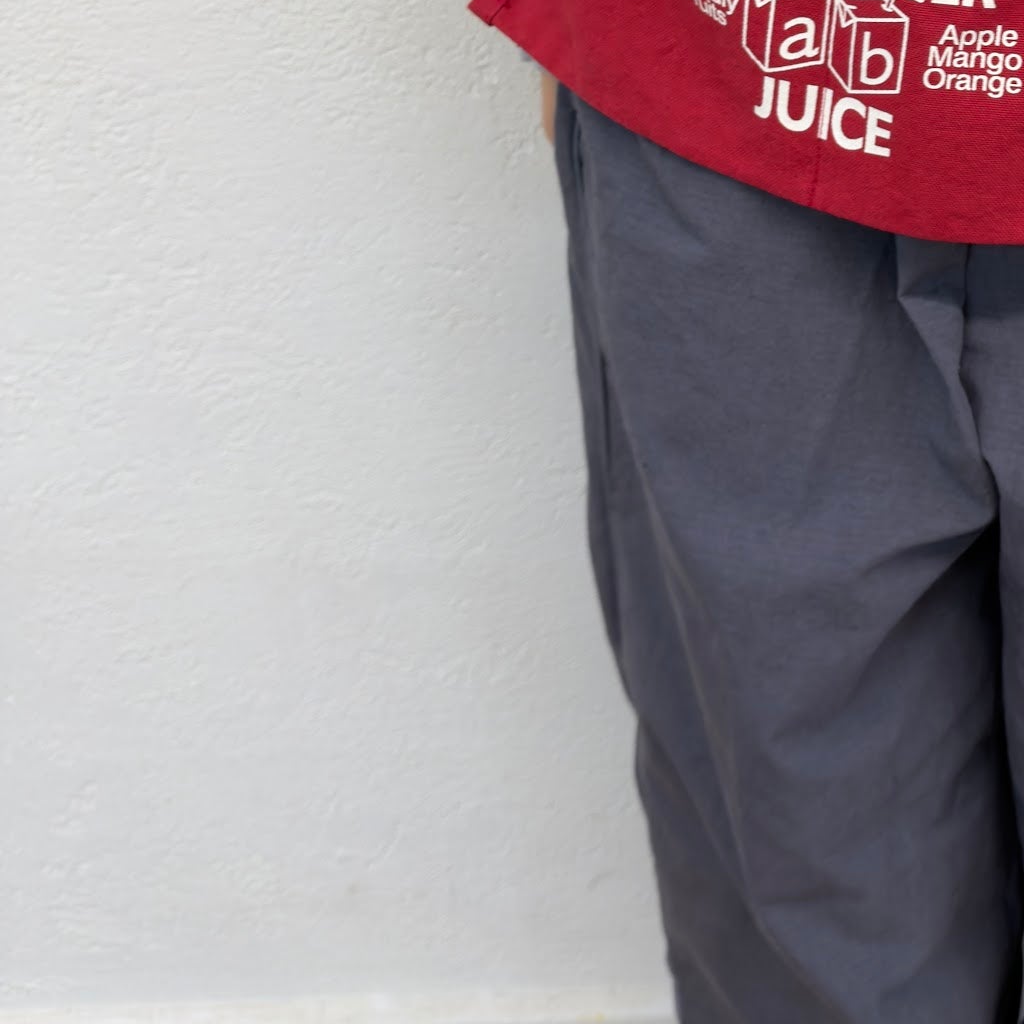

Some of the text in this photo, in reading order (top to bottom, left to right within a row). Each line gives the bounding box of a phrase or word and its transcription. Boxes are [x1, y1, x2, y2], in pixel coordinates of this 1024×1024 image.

[778, 16, 821, 61] a
[938, 24, 1019, 54] Apple
[860, 31, 894, 85] b
[927, 46, 1023, 77] Mango
[922, 68, 1023, 99] Orange
[753, 75, 894, 157] JUICE
